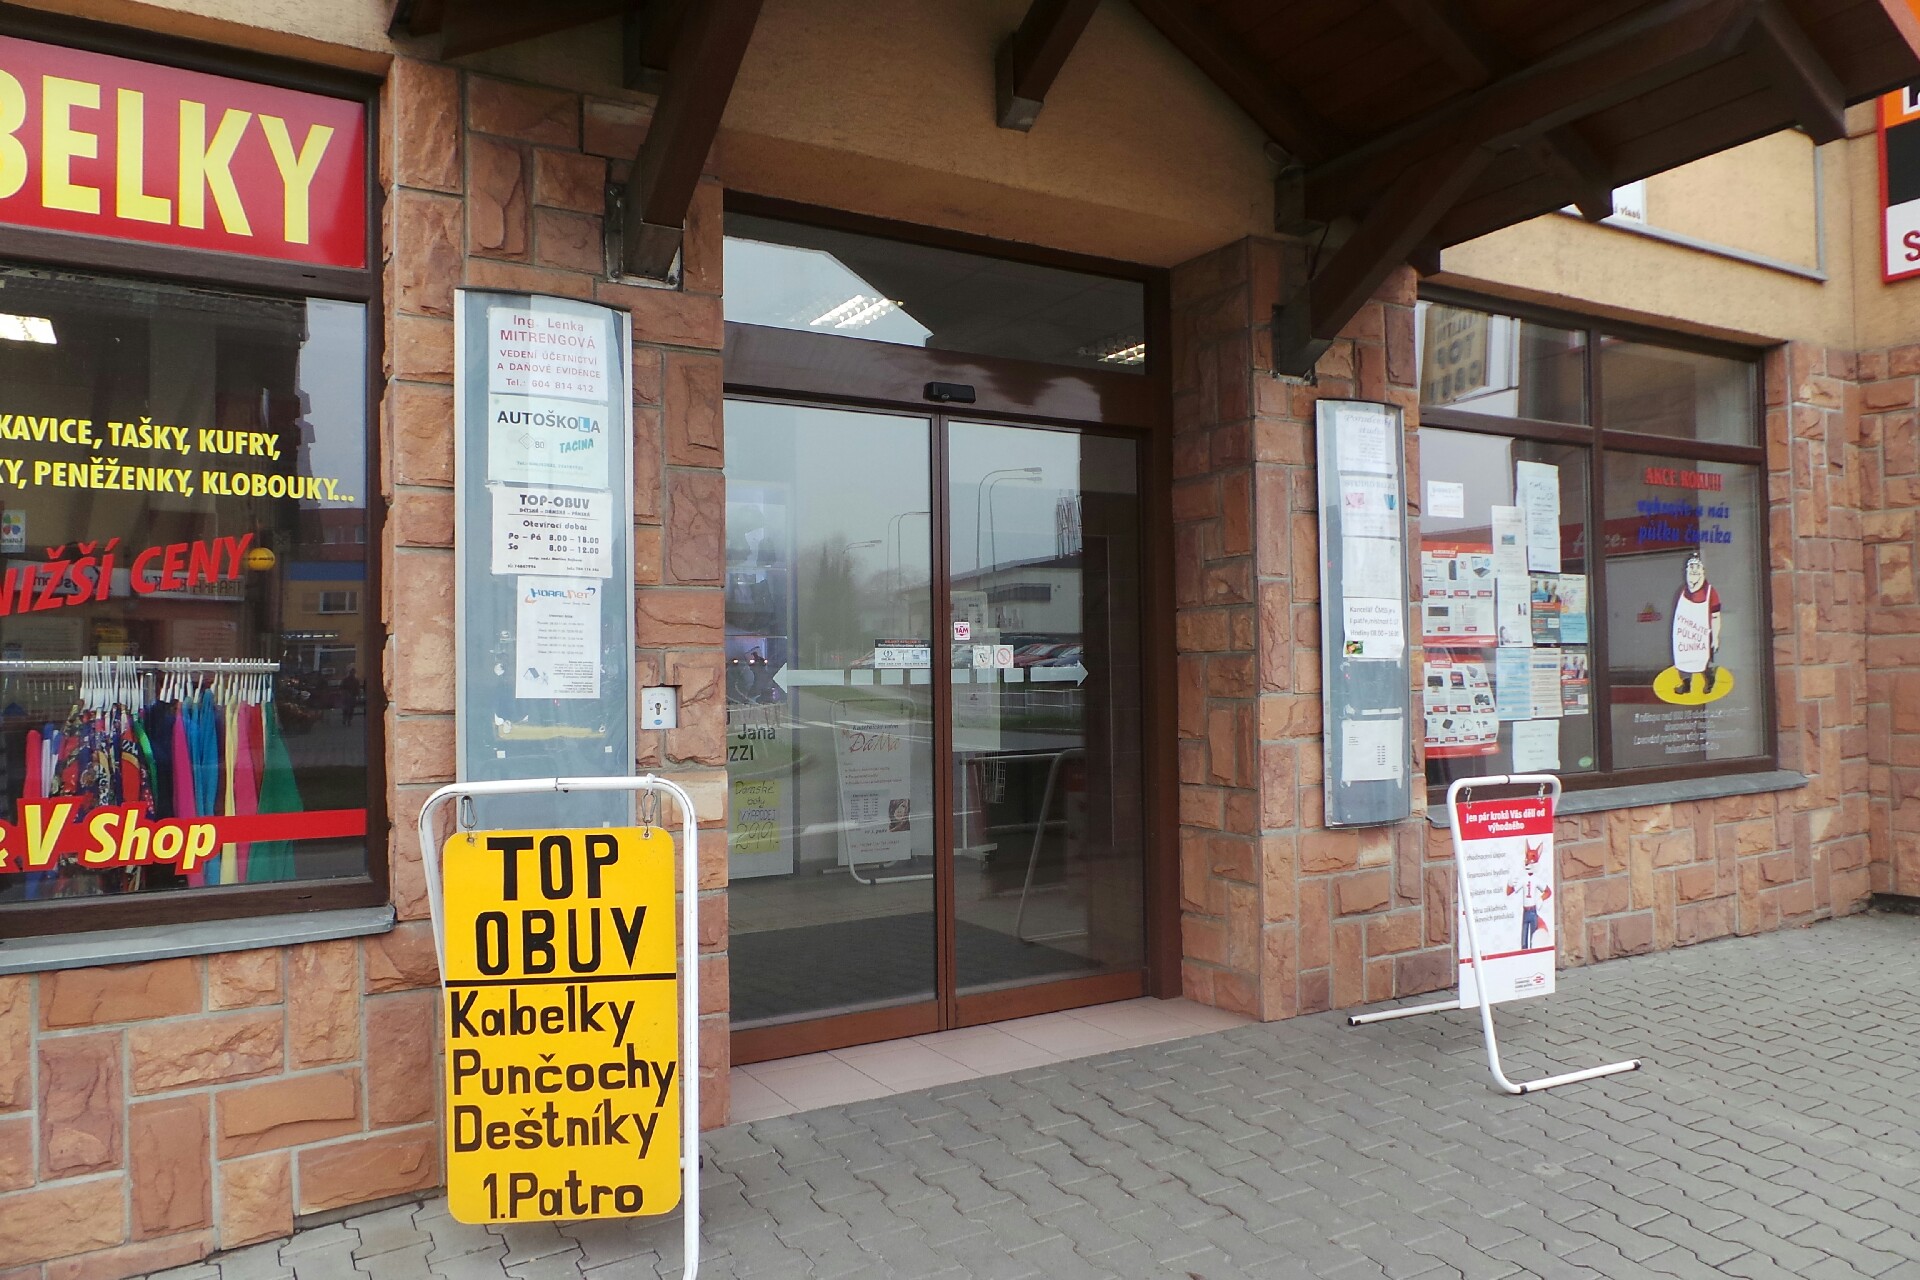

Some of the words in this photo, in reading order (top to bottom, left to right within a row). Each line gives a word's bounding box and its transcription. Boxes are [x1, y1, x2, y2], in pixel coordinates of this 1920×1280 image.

[547, 317, 584, 332] Lenka
[500, 329, 596, 350] MITRENGOVÁ
[500, 349, 538, 359] VEDENÍ
[542, 351, 597, 366] ÚČETNICTVÍ
[497, 362, 504, 370] A
[556, 366, 601, 379] EVIDENCE
[532, 380, 550, 388] 604
[555, 381, 573, 390] 814
[577, 384, 594, 393] 412
[497, 410, 601, 433] AUTOŠKOLA
[107, 416, 191, 456] TAŠKY,
[199, 429, 281, 460] KUFRY,
[34, 456, 194, 498] PENĚŽENKY,
[202, 471, 355, 502] KLOBOUKY...
[520, 494, 590, 510] TOP-OBUV
[1708, 502, 1729, 519] nás
[507, 542, 519, 550] So
[549, 544, 567, 552] 8.00
[508, 532, 519, 540] Po
[530, 533, 541, 541] Pá
[549, 534, 567, 542] 8.00
[129, 533, 254, 594] CENY
[737, 723, 776, 740] Jana
[1478, 812, 1490, 823] pár
[1510, 809, 1523, 819] Vás
[1536, 808, 1546, 817] od
[24, 803, 72, 866] V
[84, 809, 217, 870] Shop
[1488, 820, 1525, 834] výhodného
[486, 834, 619, 901] TOP
[475, 905, 648, 976] OBUV
[450, 985, 636, 1048] Kabelky
[453, 1043, 677, 1108] Punčochy
[454, 1098, 659, 1160] Deštníky
[483, 1170, 644, 1219] 1.Patro
